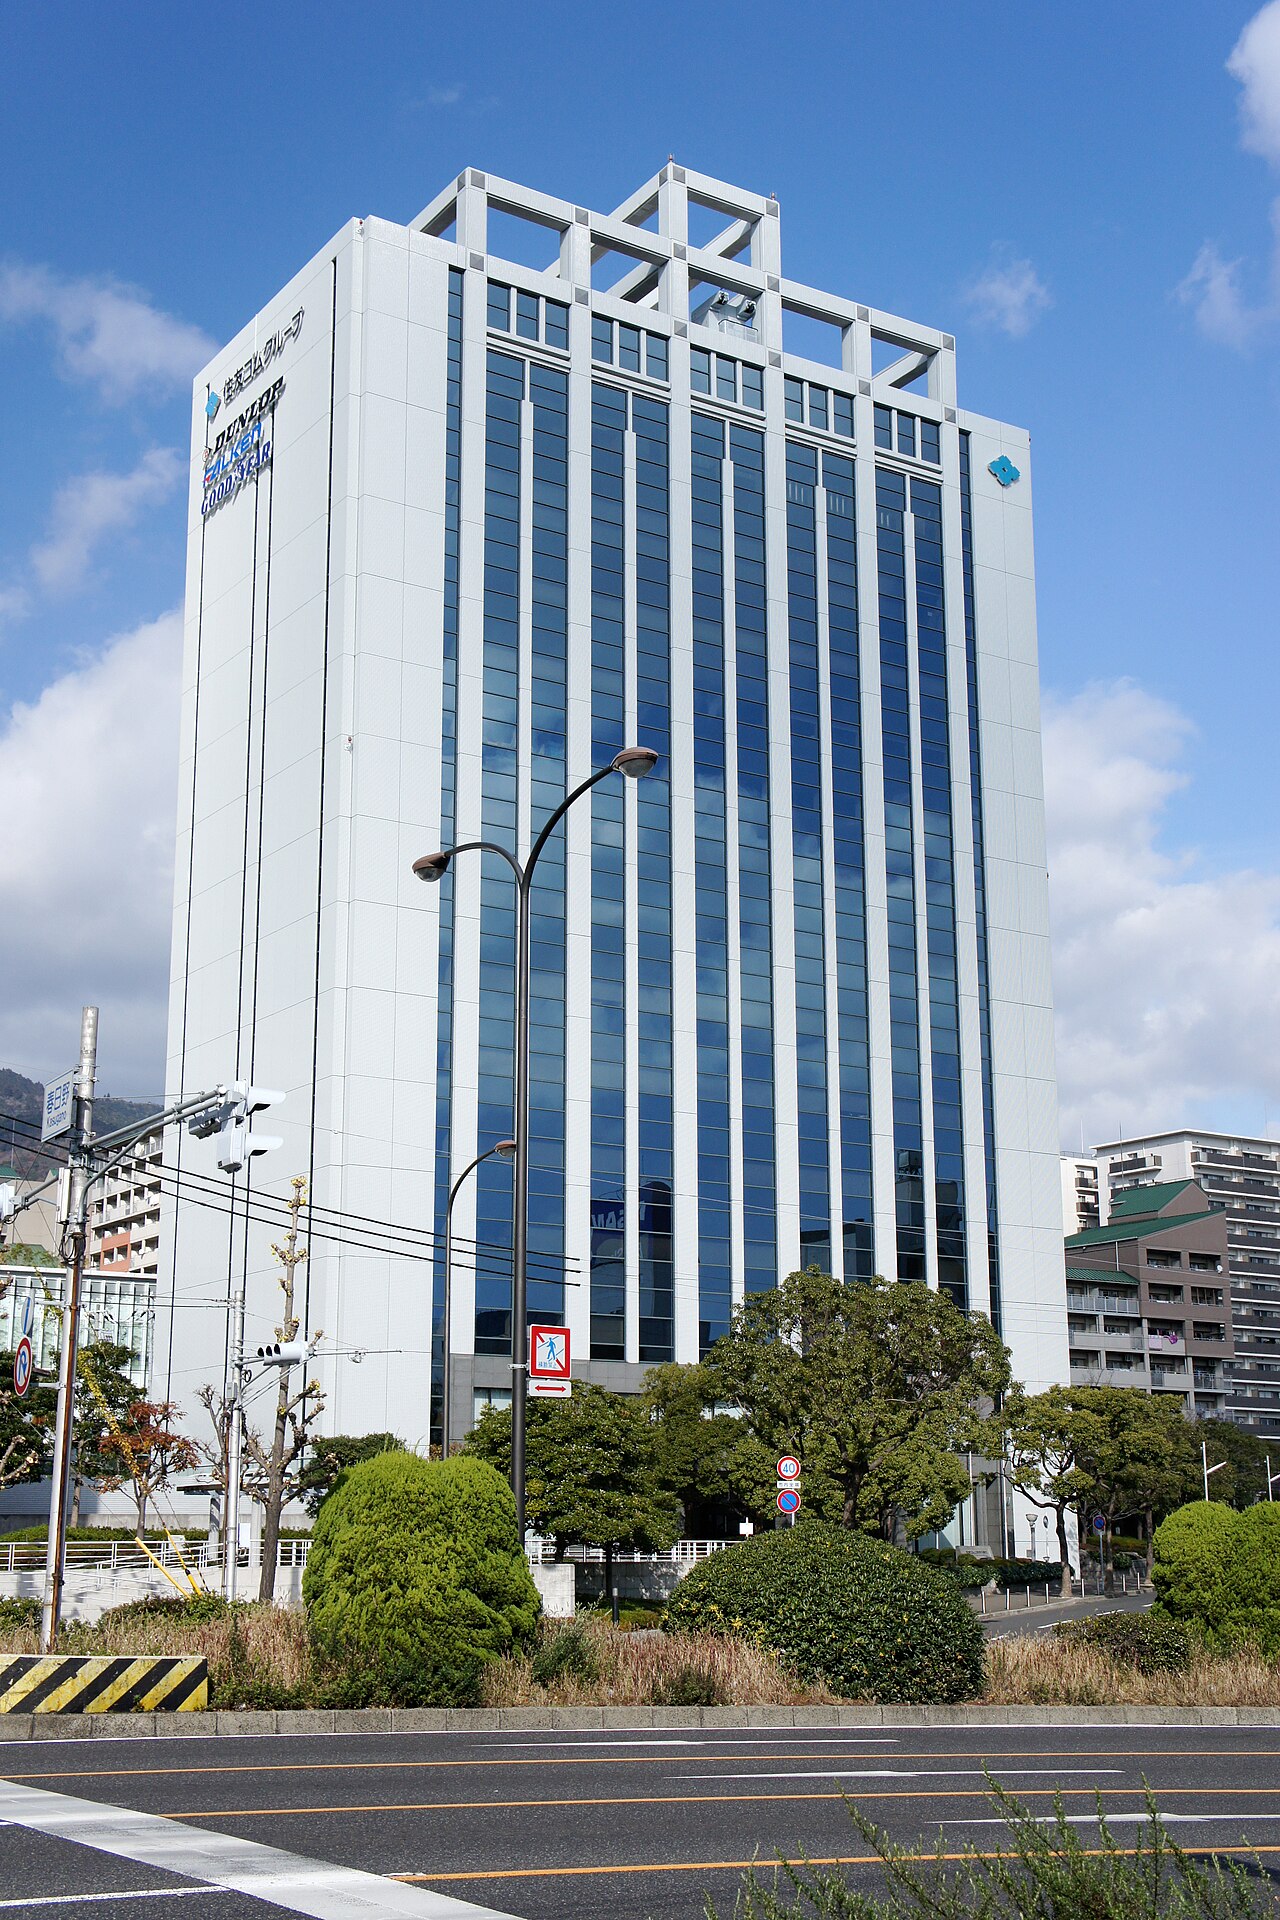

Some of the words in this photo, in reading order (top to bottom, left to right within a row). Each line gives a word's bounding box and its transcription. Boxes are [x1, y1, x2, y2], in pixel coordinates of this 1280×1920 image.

[223, 306, 304, 401] 住友ゴムグループ
[213, 376, 284, 455] DUNLOP
[46, 1081, 71, 1115] 春日野
[782, 1462, 796, 1473] 40
